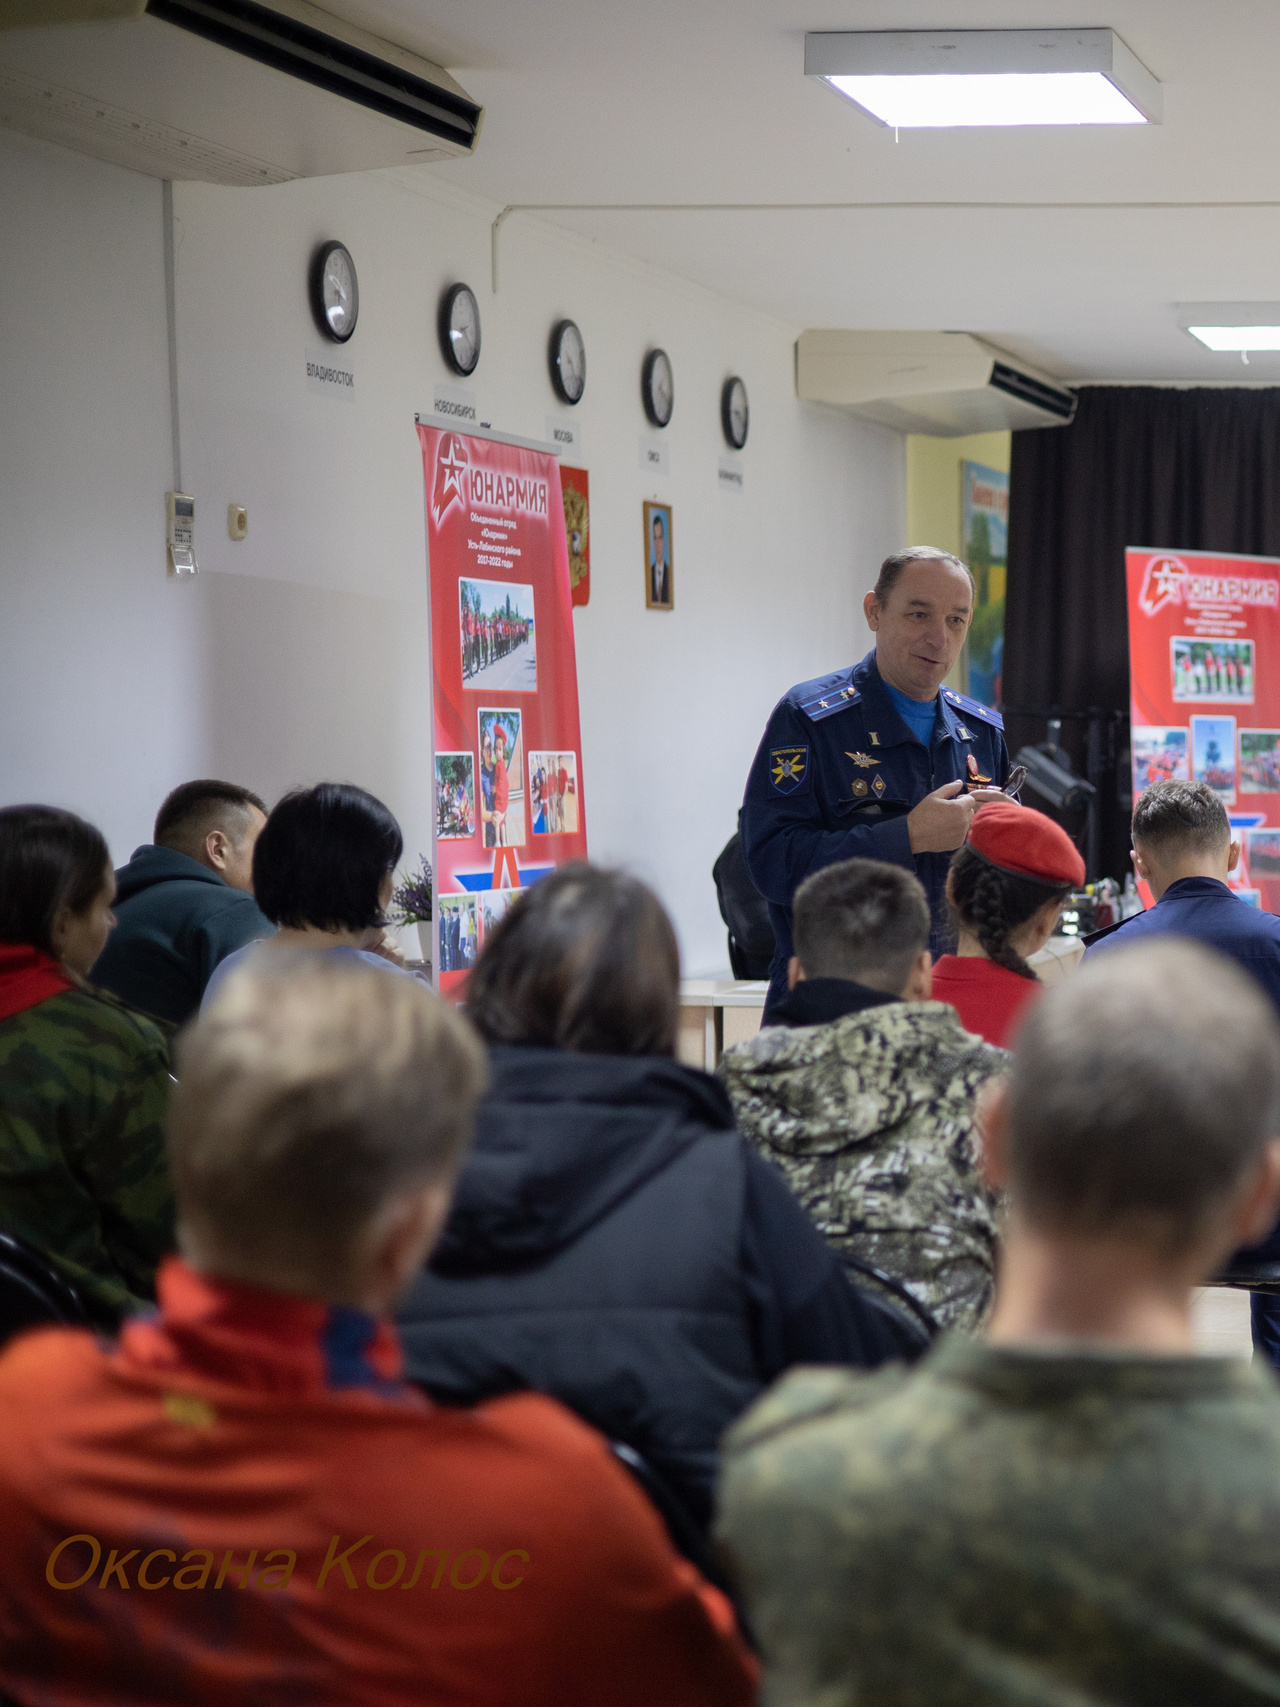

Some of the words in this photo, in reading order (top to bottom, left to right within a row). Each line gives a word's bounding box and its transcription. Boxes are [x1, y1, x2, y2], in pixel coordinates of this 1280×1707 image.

[306, 362, 355, 388] ВЛАДИВОСТОК
[434, 398, 476, 420] НОВОСИБИРСК
[554, 428, 574, 444] МОСКВА
[470, 469, 548, 514] ЮНАРМИЯ
[477, 555, 501, 566] 2017-2022
[1187, 578, 1276, 602] ЮНАРМИЯ
